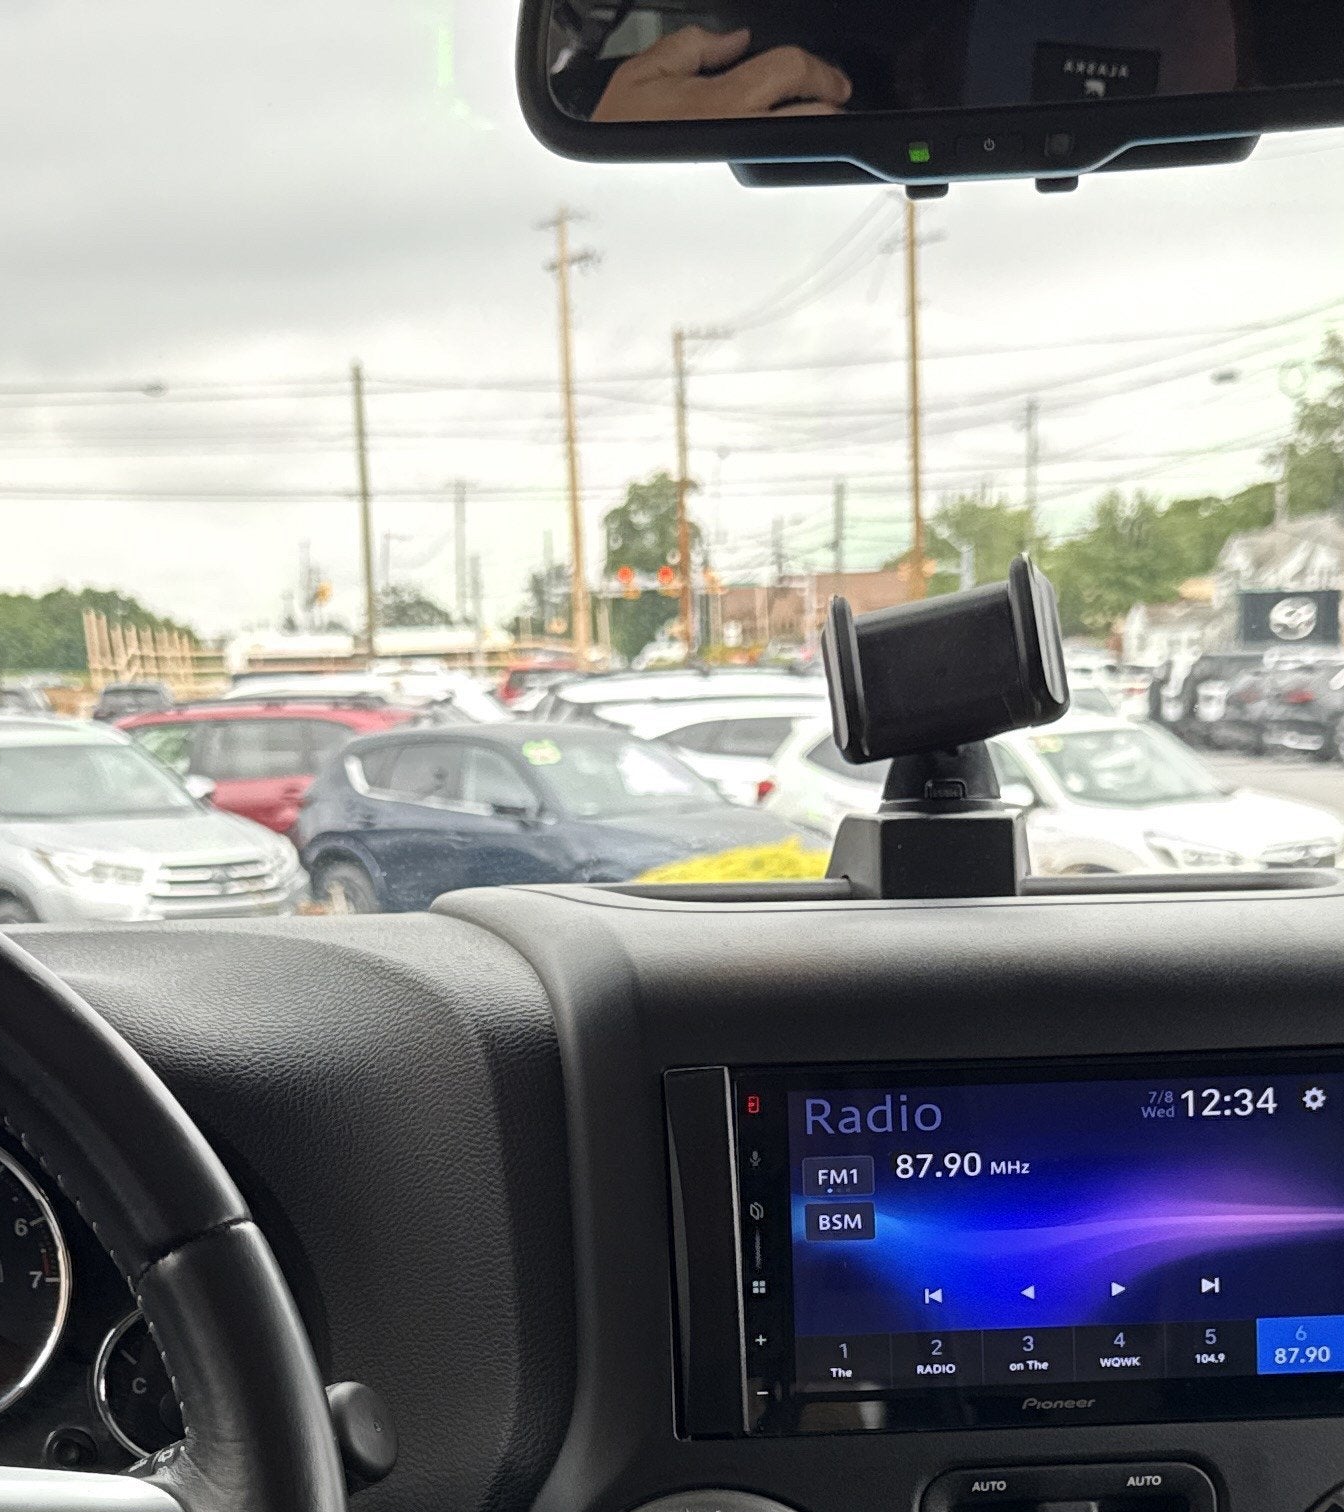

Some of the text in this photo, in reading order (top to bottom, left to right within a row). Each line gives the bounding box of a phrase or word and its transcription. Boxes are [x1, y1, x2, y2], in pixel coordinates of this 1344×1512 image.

[1148, 1090, 1174, 1104] 7/8
[1180, 1086, 1278, 1117] 12:34
[806, 1094, 943, 1135] Radio
[1141, 1105, 1175, 1118] Wed
[895, 1152, 1031, 1179] 87.90 MHz
[817, 1168, 859, 1186] FM1
[14, 1218, 28, 1237] 6
[818, 1213, 862, 1232] BSM
[29, 1271, 43, 1290] 7
[1113, 1332, 1126, 1348] 4
[1205, 1328, 1218, 1345] 5
[1294, 1325, 1307, 1341] 6
[838, 1343, 849, 1359] 1
[930, 1339, 943, 1356] 2
[1022, 1335, 1035, 1352] 3
[1099, 1354, 1141, 1369] WQWK
[1194, 1352, 1226, 1364] 104.9
[1273, 1346, 1332, 1365] 87.90
[830, 1367, 854, 1379] The
[916, 1363, 957, 1375] RADIO
[1009, 1360, 1050, 1372] on The
[132, 1377, 147, 1394] C
[1022, 1397, 1096, 1411] Pioneer
[972, 1480, 1006, 1492] AUTO
[1126, 1475, 1162, 1487] AUTO
